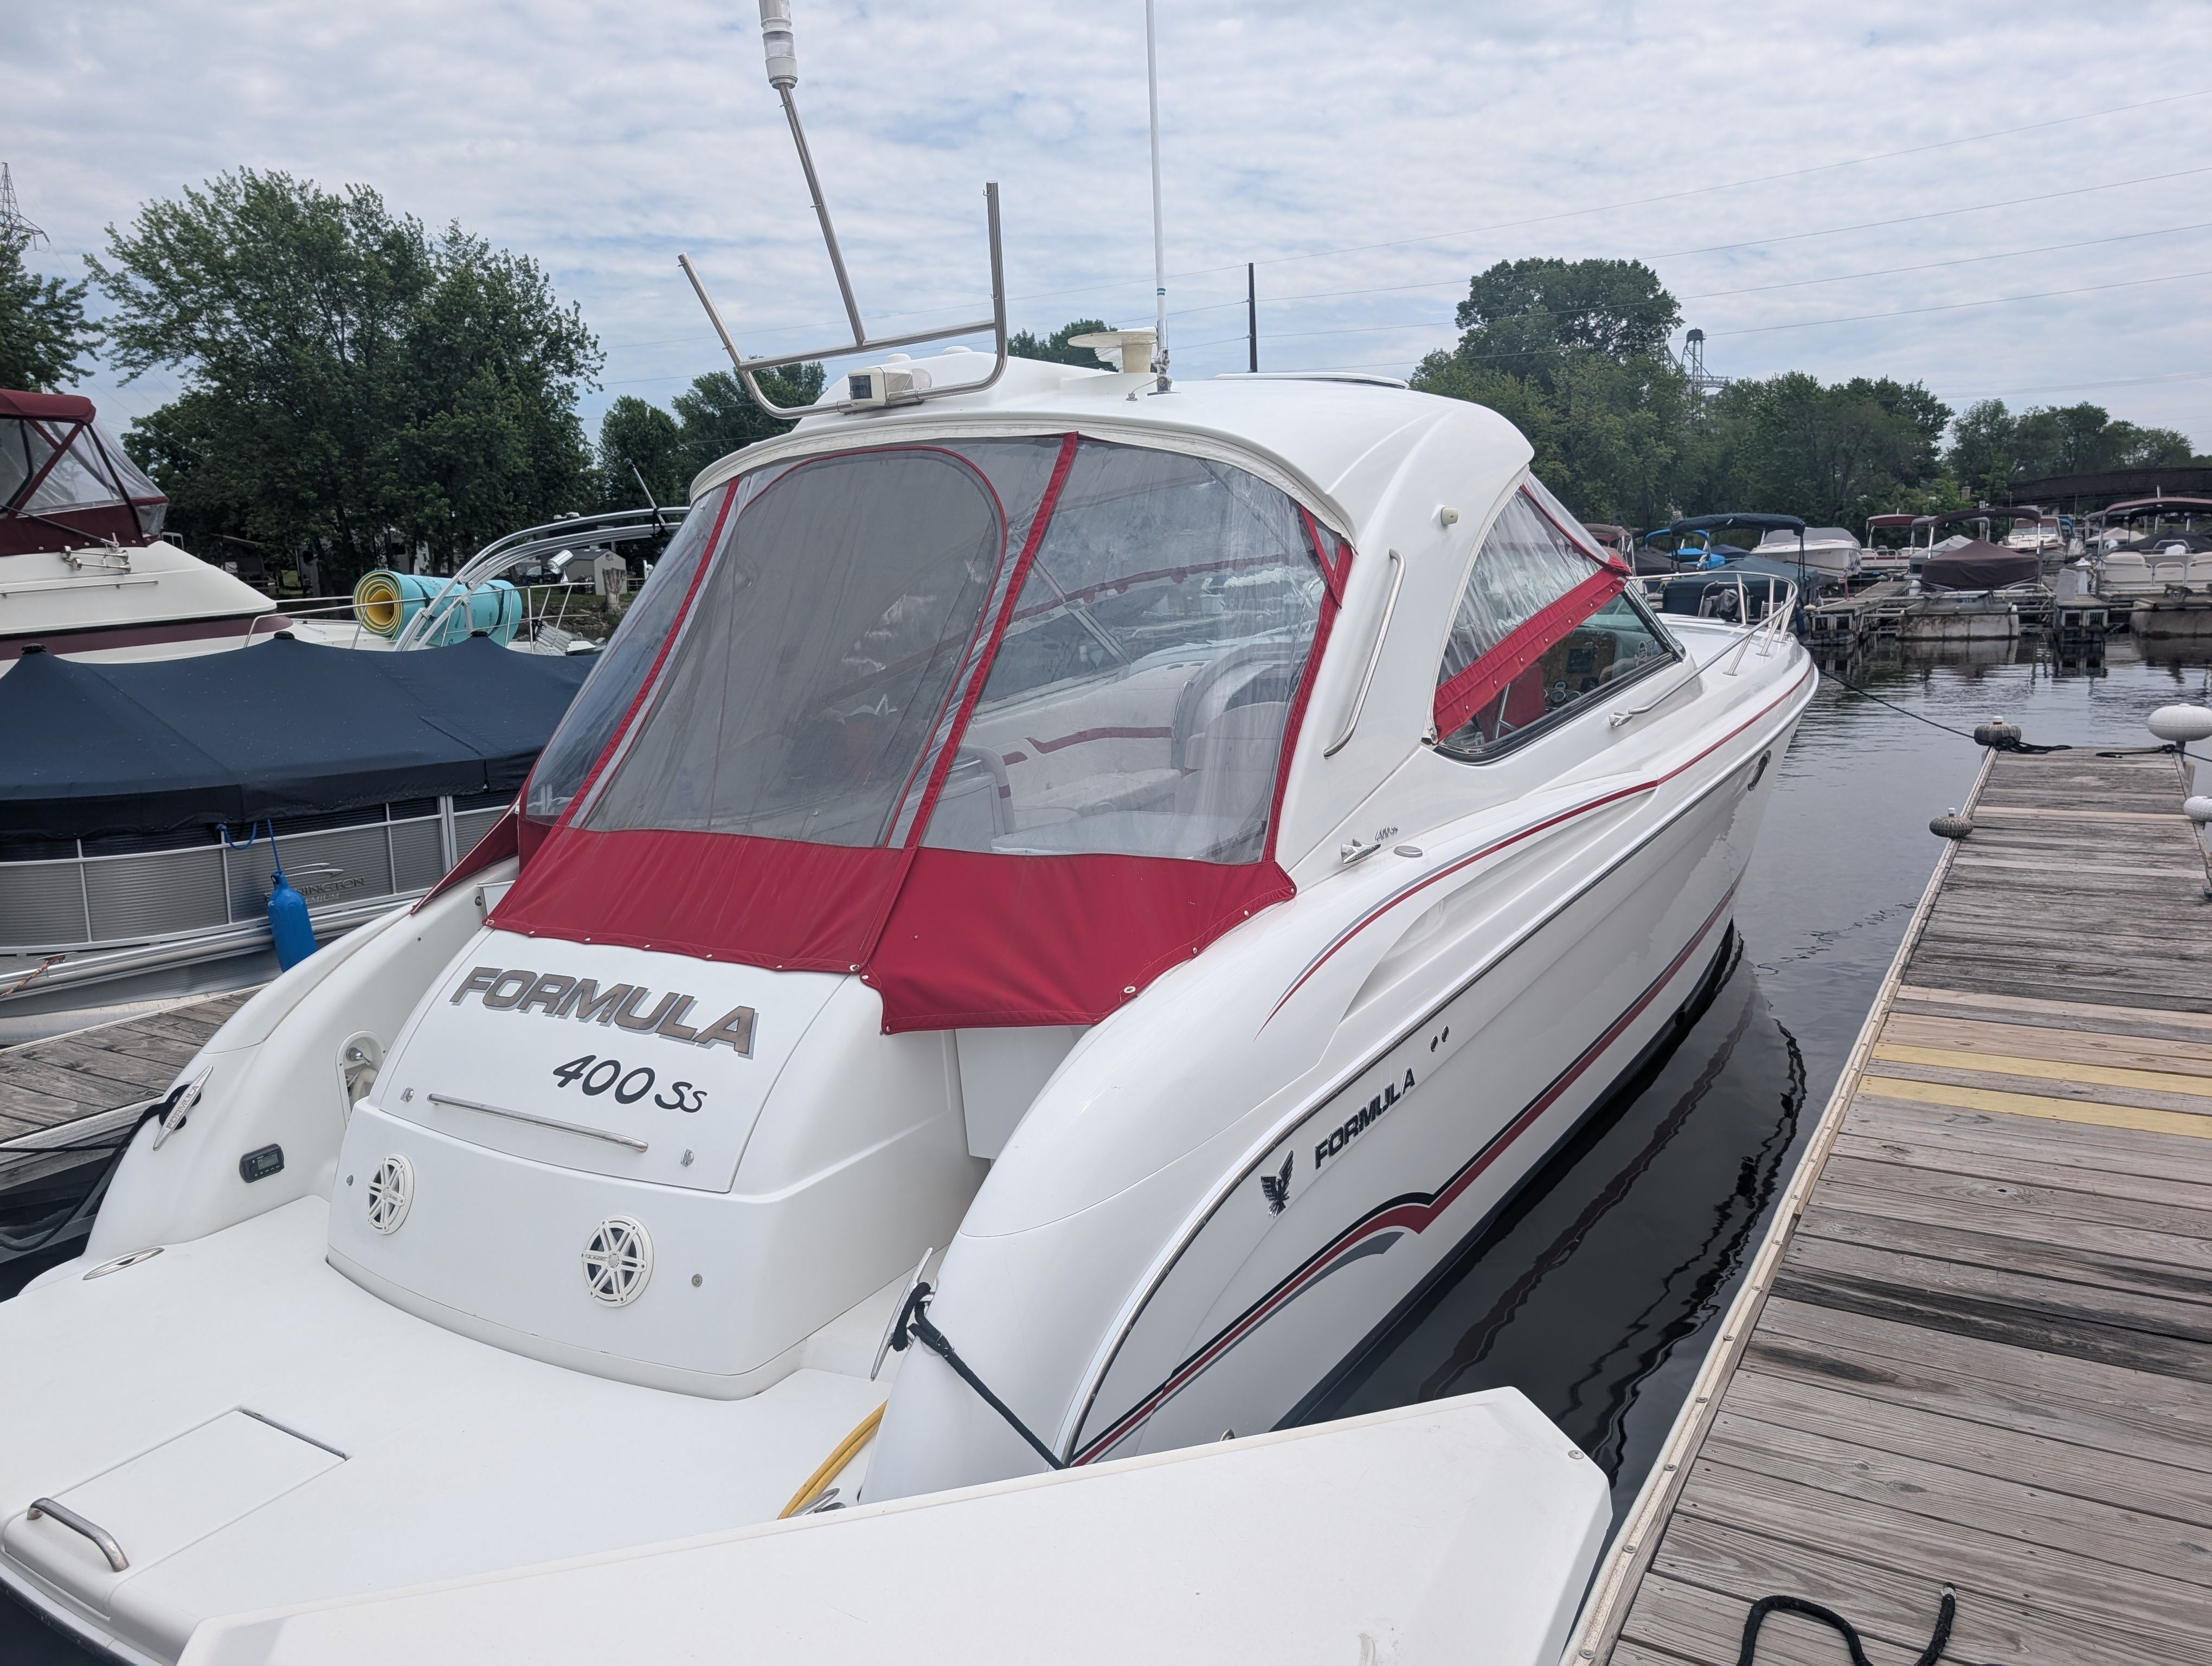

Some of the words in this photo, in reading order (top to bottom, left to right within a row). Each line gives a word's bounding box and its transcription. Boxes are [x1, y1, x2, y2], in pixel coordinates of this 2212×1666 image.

[305, 893, 339, 905] EMIUM
[449, 966, 758, 1060] FORMULA
[553, 1054, 655, 1104] 400
[1314, 1067, 1416, 1170] FORMULA
